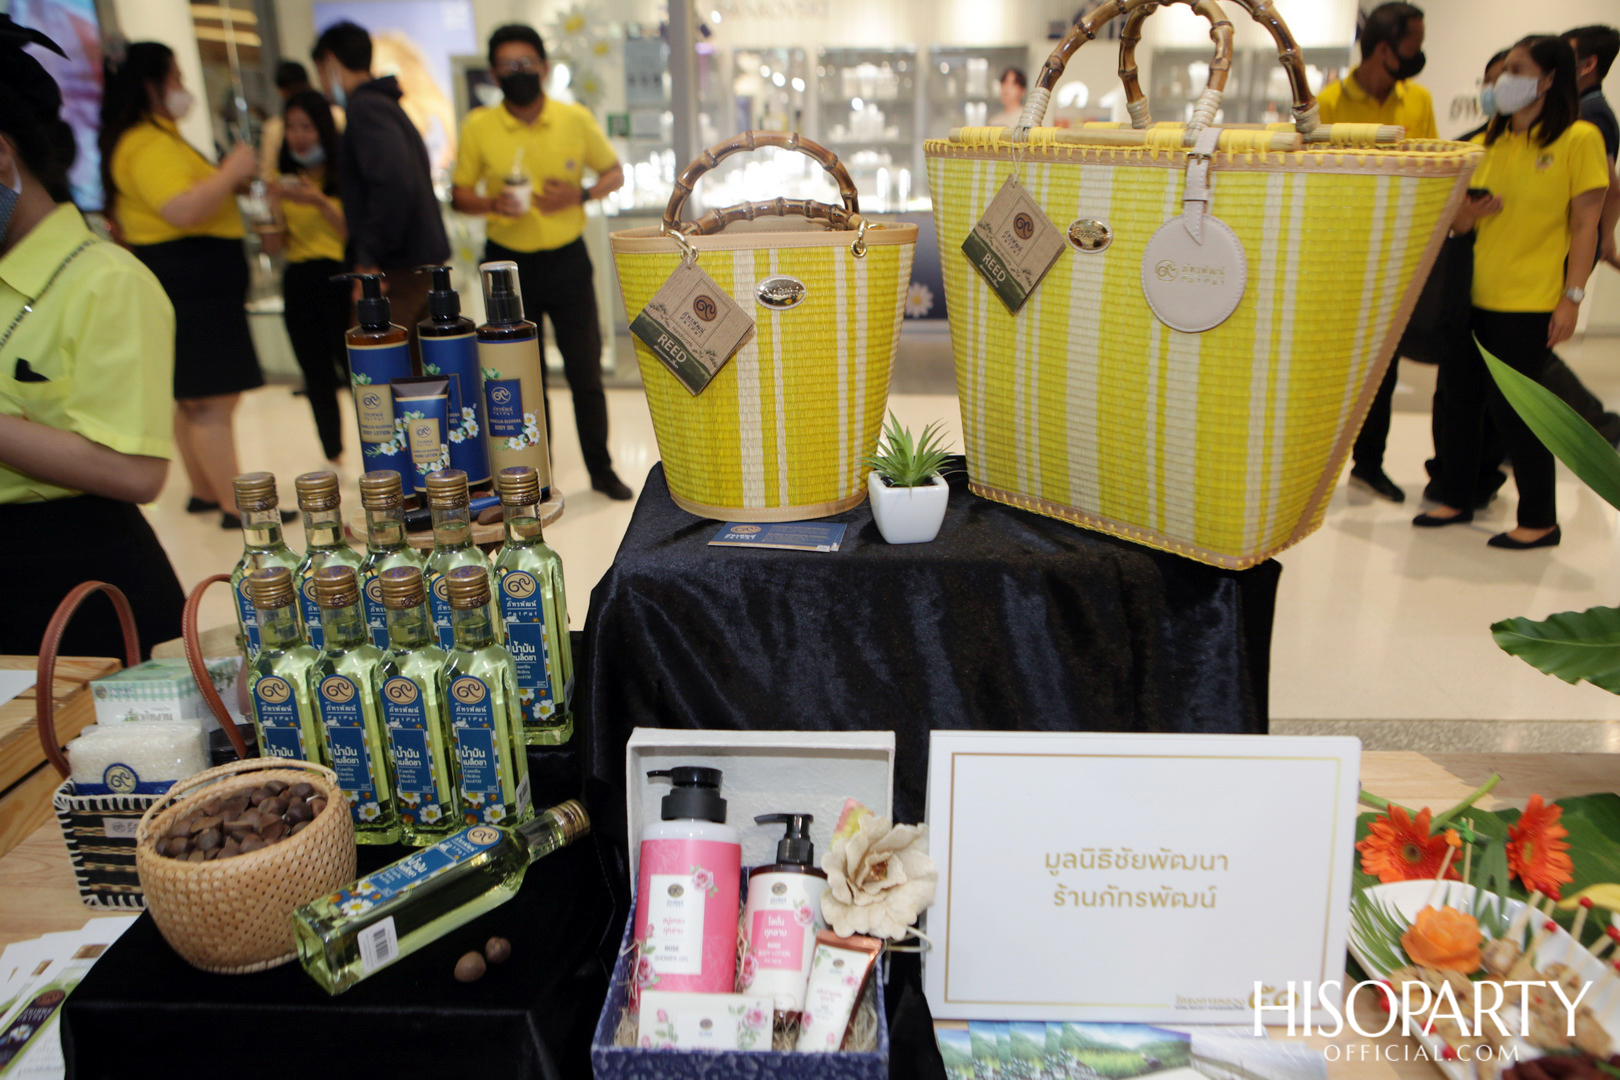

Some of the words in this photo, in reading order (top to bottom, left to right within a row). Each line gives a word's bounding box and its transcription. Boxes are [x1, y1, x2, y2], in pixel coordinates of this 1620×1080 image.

[982, 253, 1007, 282] REED
[657, 334, 687, 363] REED
[506, 599, 537, 608] ภัทรพัฒน์
[512, 640, 535, 654] น้ำมัน
[262, 704, 292, 712] ภัทรพัฒน์
[326, 704, 356, 712] ภัทรพัฒน์
[389, 705, 419, 713] ภัทรพัฒน์
[456, 705, 487, 713] ภัทรพัฒน์
[270, 744, 294, 757] น้ำมัน
[334, 744, 358, 757] น้ำมัน
[396, 745, 420, 758] น้ำมัน
[462, 745, 486, 758] น้ำมัน
[1044, 847, 1229, 877] มูลนิธิชัยพัฒนา
[1053, 883, 1218, 909] ร้านภัทรพัฒน์
